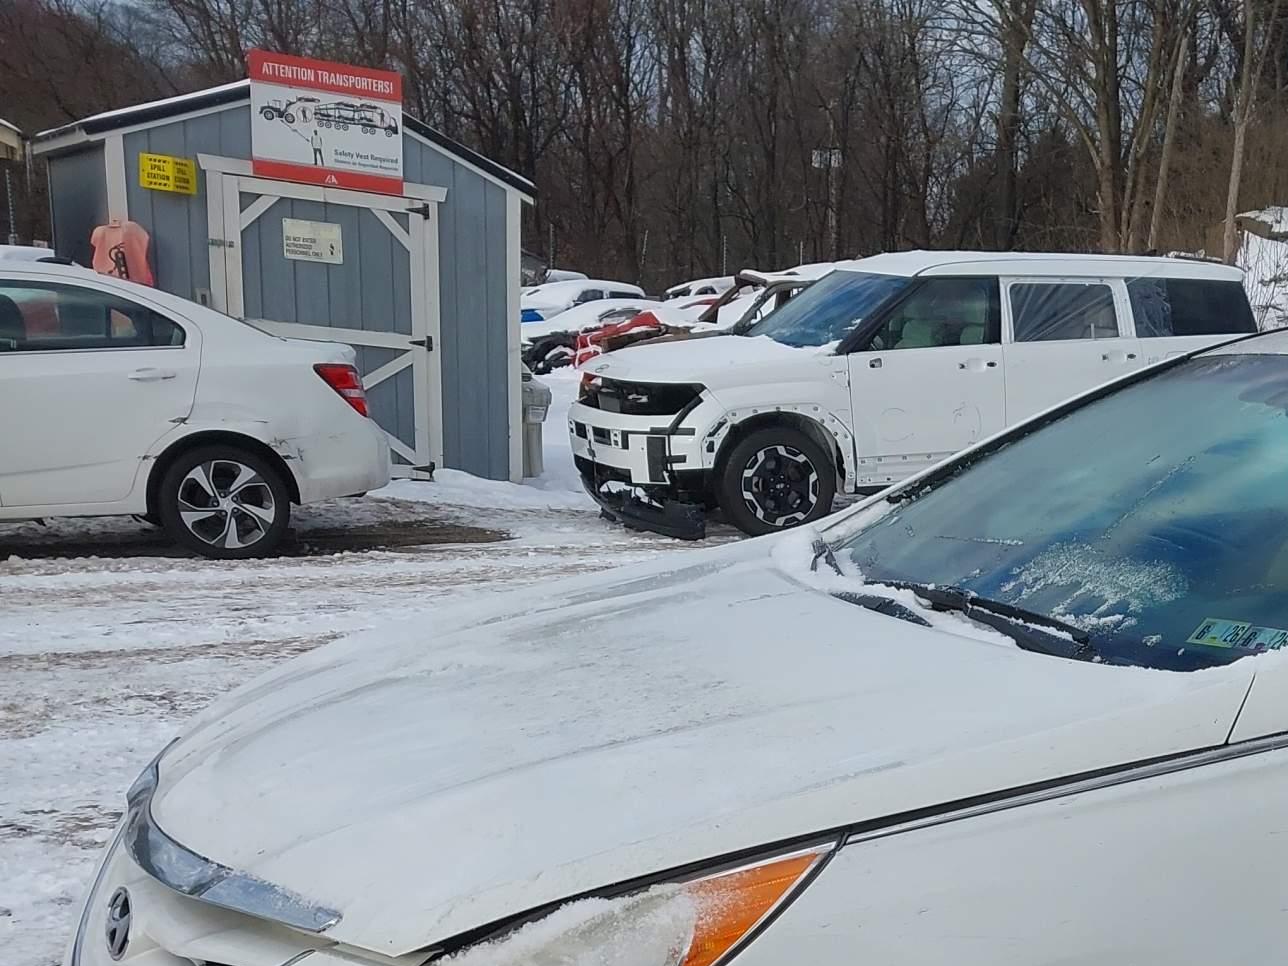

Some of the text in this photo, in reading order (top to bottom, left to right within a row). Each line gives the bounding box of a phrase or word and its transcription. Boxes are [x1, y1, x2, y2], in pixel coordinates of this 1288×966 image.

[262, 62, 394, 94] ATTENTION TRANSPORTERS!
[334, 149, 354, 159] Safety
[355, 152, 369, 160] Vest
[147, 172, 170, 181] STATION
